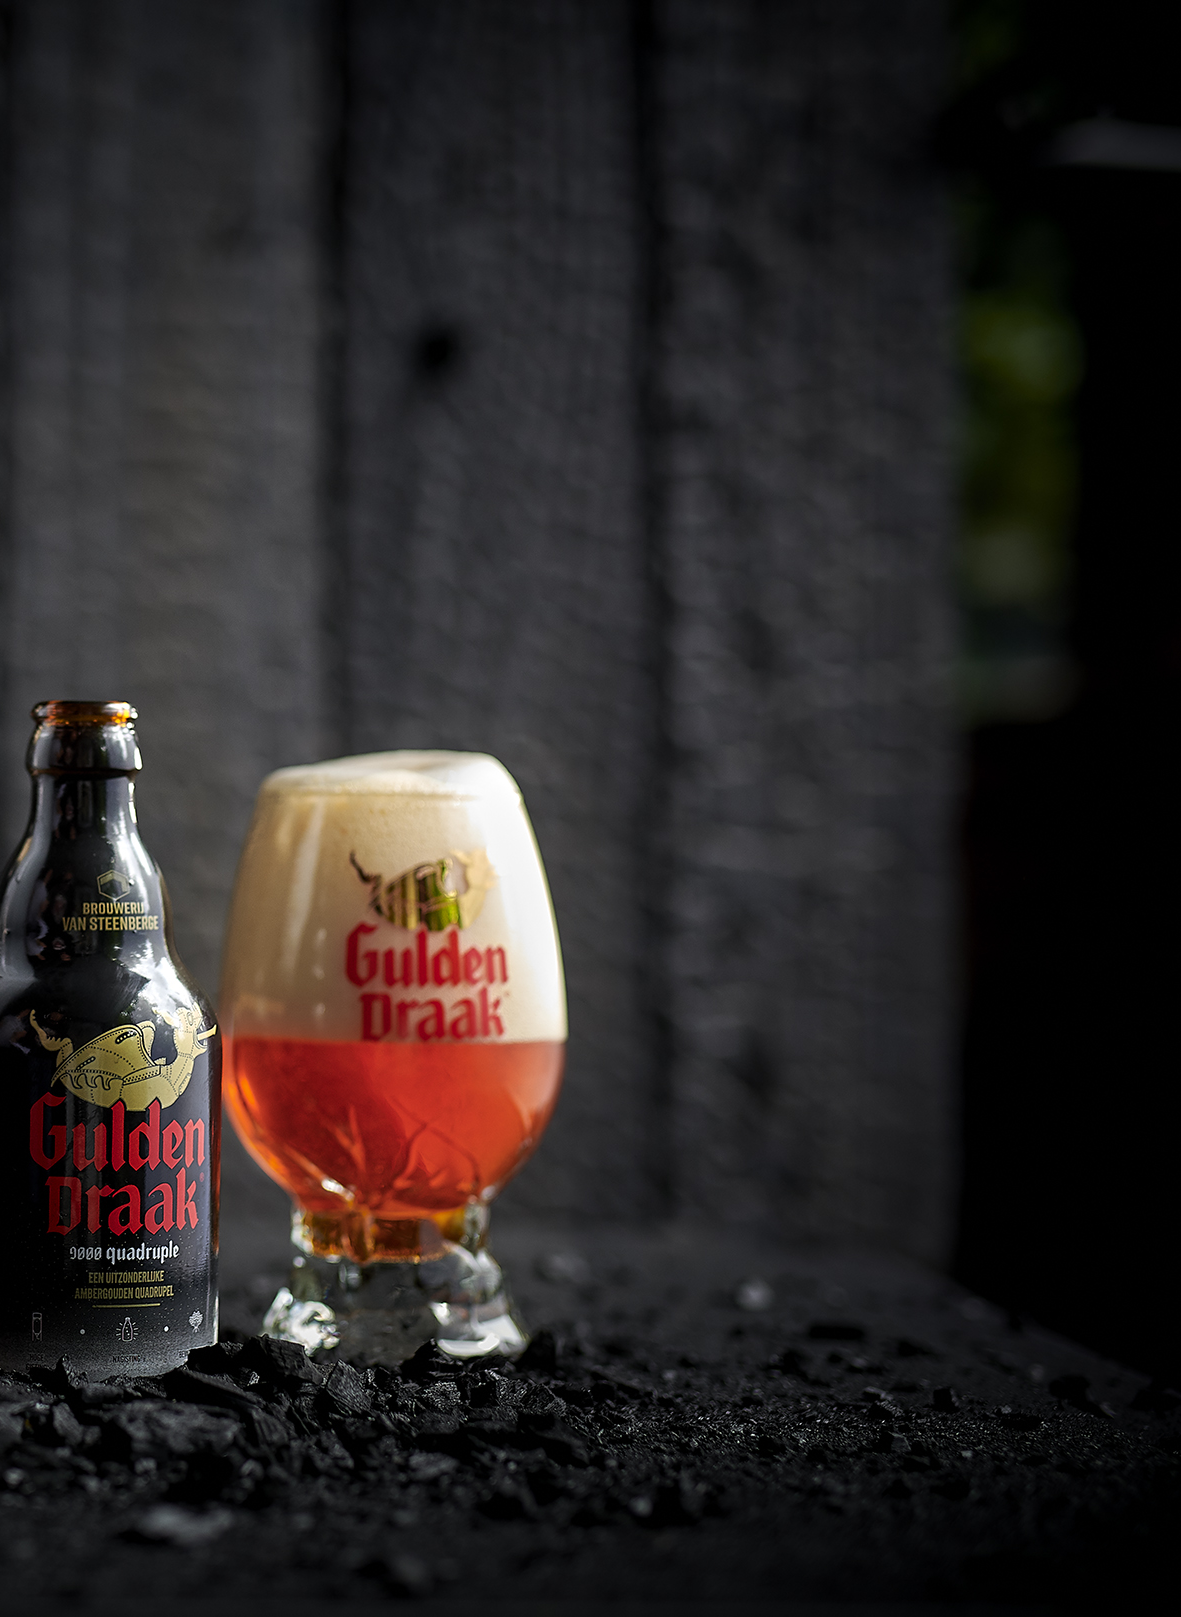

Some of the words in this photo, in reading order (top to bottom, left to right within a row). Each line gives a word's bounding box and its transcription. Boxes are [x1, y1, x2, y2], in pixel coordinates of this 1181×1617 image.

[82, 902, 145, 915] BROUWERIJ
[62, 917, 87, 932] VAN
[89, 915, 159, 932] STEENBERGE
[345, 921, 509, 988] Gulden
[360, 986, 505, 1042] Draak
[29, 1091, 206, 1172] Gulden
[44, 1167, 199, 1236] Draak
[106, 1240, 179, 1265] quadruple
[88, 1271, 105, 1284] EEN
[74, 1287, 134, 1300] AMBERGOUDEN
[134, 1285, 174, 1299] QUADRUPEL
